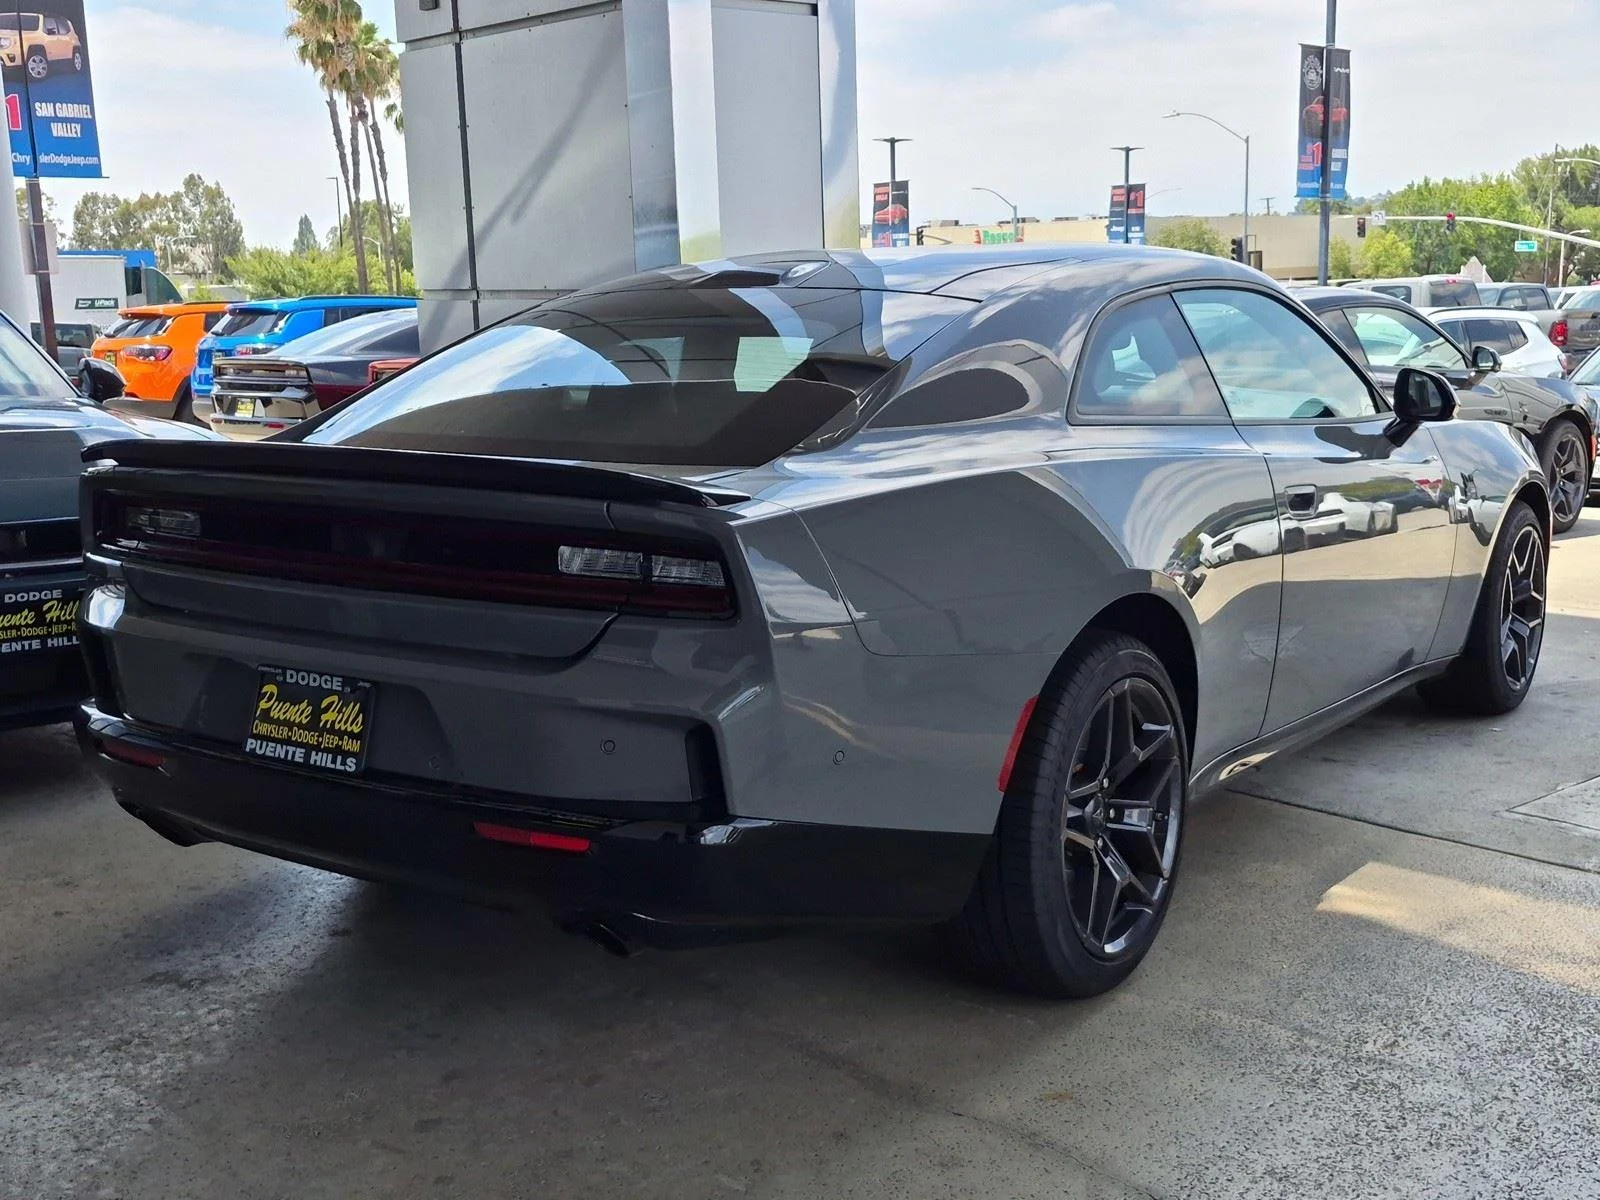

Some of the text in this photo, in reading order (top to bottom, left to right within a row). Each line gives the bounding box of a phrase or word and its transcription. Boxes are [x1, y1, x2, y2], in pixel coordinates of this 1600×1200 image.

[34, 102, 92, 119] SAN GABRIEL
[50, 122, 81, 138] VALLEY
[4, 589, 63, 603] DODGE
[42, 600, 80, 623] Hill
[1, 635, 80, 653] ENTE HILL
[285, 669, 344, 691] DODGE
[255, 684, 363, 733] Puente Hills
[245, 737, 357, 773] PUENTE HILLS
